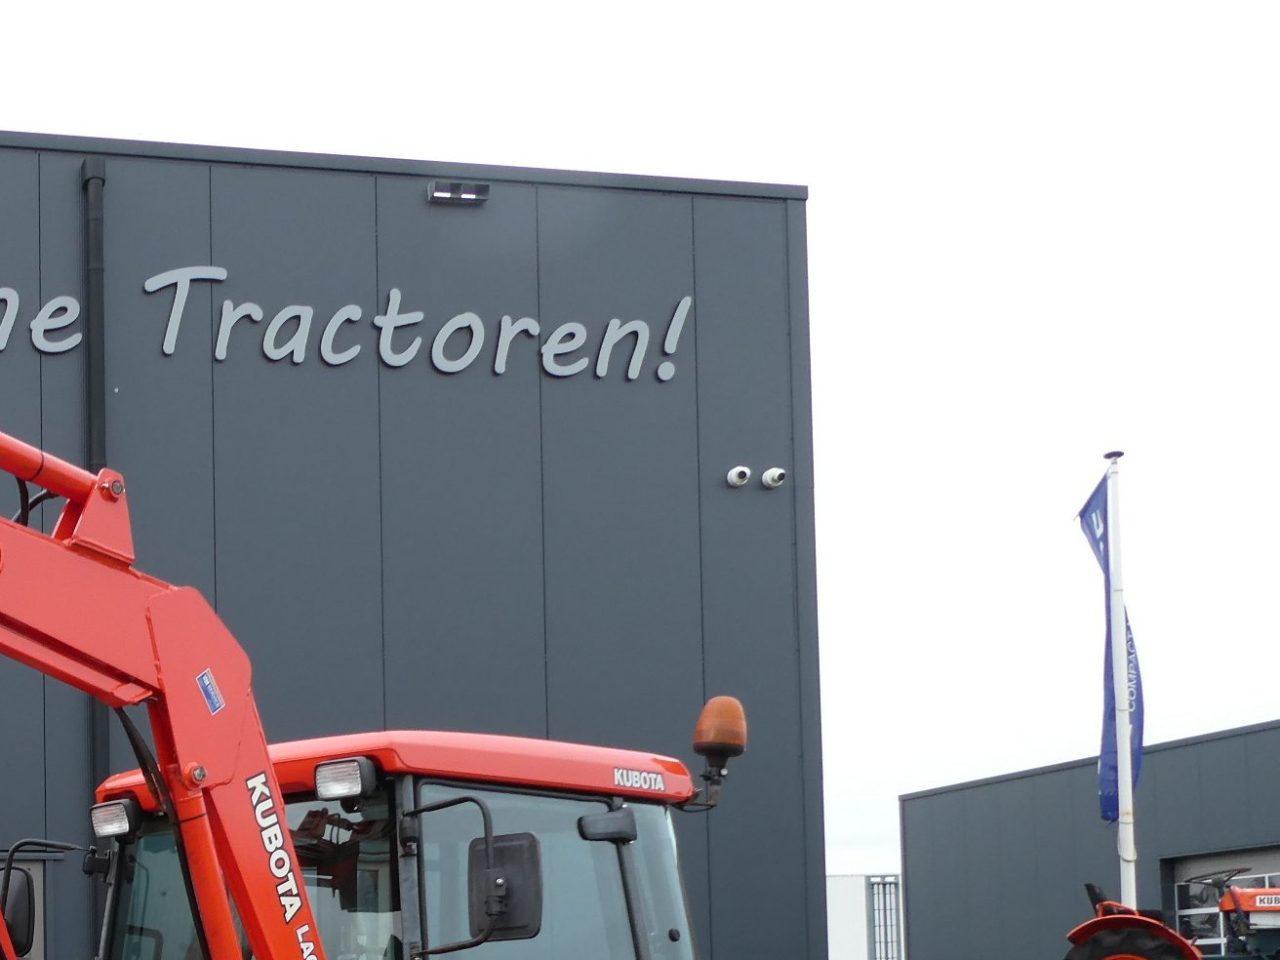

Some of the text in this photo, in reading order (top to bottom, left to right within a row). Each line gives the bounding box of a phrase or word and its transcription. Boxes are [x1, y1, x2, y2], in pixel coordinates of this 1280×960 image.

[144, 265, 692, 381] Tractoren!
[614, 768, 664, 790] KUBOTA
[246, 772, 303, 923] KUBOTA
